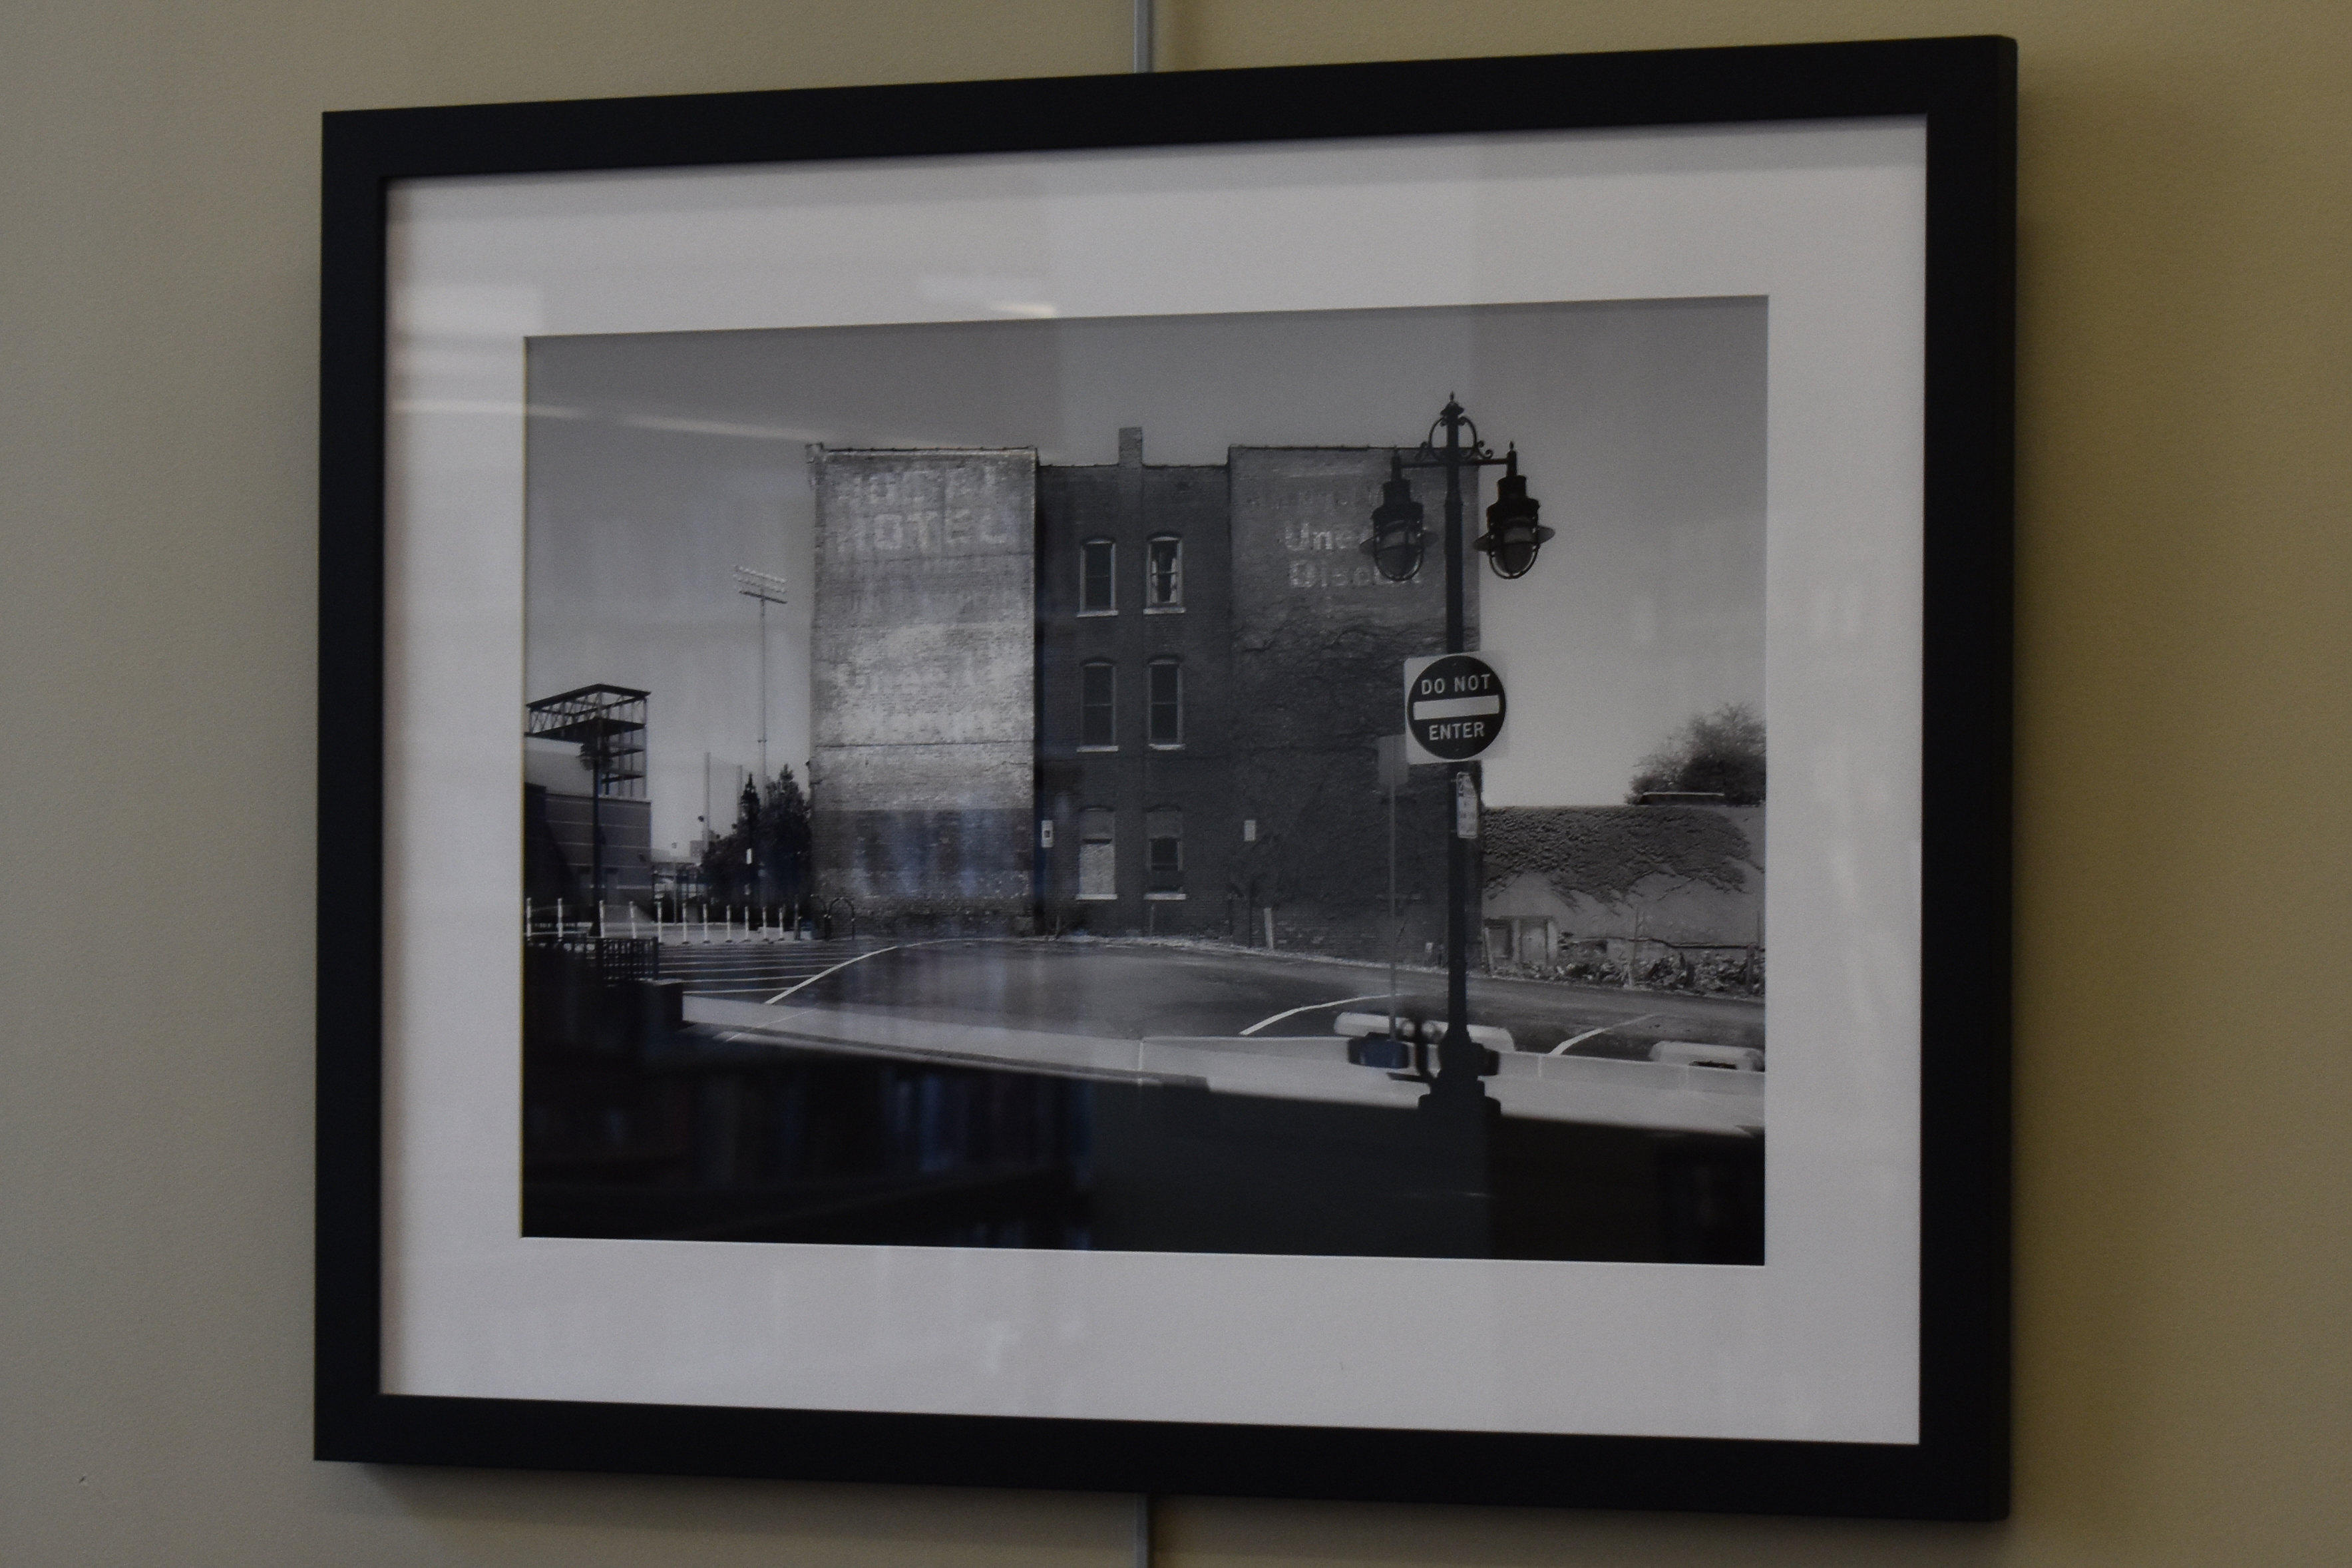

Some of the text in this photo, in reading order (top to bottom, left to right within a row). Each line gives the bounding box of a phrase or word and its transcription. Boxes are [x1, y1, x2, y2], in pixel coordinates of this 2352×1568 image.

[836, 508, 1009, 553] HOTEL
[1421, 674, 1491, 695] DO NOT
[1428, 721, 1485, 741] ENTER
